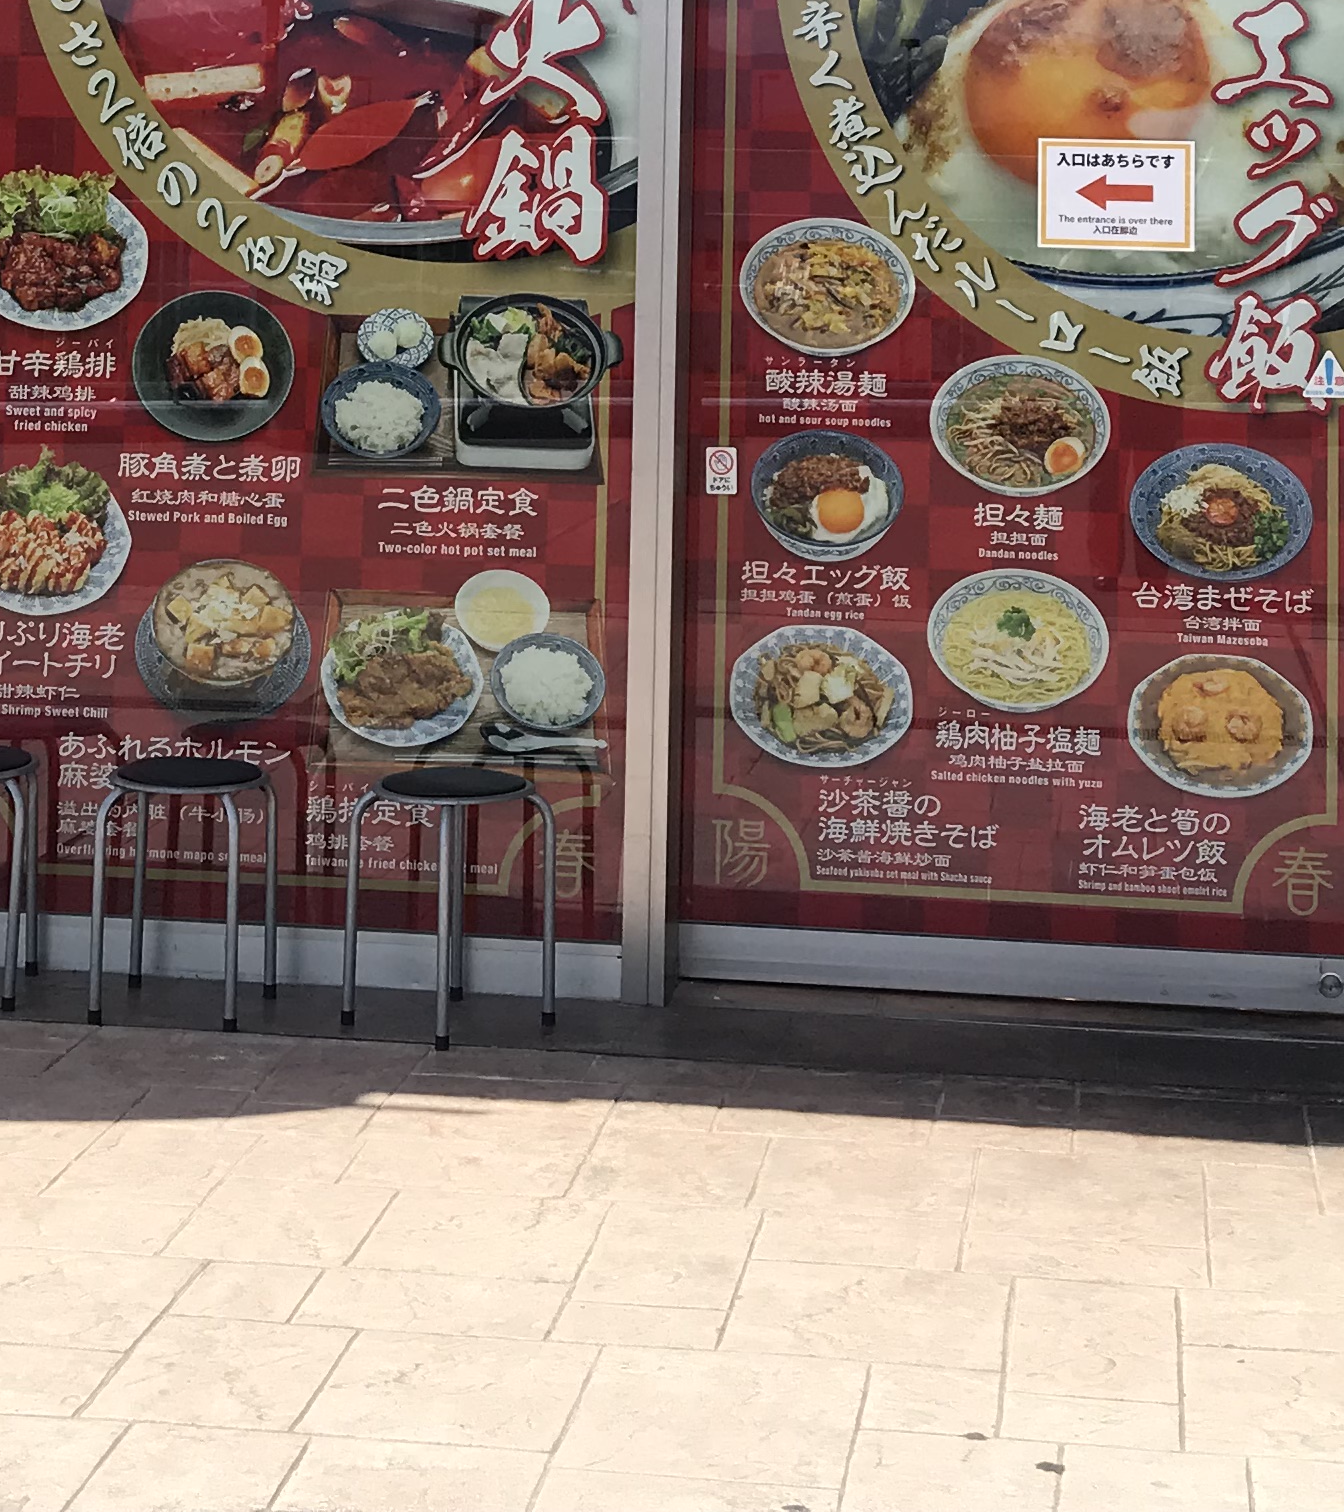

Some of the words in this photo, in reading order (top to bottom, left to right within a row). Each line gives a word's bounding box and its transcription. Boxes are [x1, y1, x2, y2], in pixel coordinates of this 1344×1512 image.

[1056, 152, 1176, 170] 入口はあちらです
[1058, 214, 1075, 225] The
[1077, 215, 1117, 226] entrance
[1119, 217, 1127, 226] is
[1129, 217, 1149, 226] over
[1150, 217, 1174, 227] there
[5, 405, 41, 418] Sweet
[67, 406, 97, 420] spicy
[759, 413, 776, 424] hot
[800, 416, 822, 426] sour
[825, 417, 850, 428] soup
[853, 416, 892, 428] noodles
[14, 418, 41, 432] fried
[44, 419, 88, 432] chicken
[117, 451, 301, 483] 豚角煮と煮卵
[377, 484, 539, 517] 二色鍋定食
[127, 509, 169, 524] Stewed
[172, 510, 201, 524] Pork
[204, 512, 225, 525] and
[228, 512, 264, 526] Boiled
[267, 513, 288, 528] Egg
[378, 541, 438, 556] Two-color
[440, 543, 461, 556] hot
[464, 544, 484, 558] pot
[487, 545, 506, 557] set
[509, 545, 538, 558] meal
[978, 548, 1016, 560] Dandan
[1018, 549, 1059, 562] noodles
[1132, 582, 1315, 614] 台湾まぜそば
[824, 609, 843, 621] egg
[844, 609, 865, 620] rice
[1177, 632, 1214, 645] Taiwan
[1217, 634, 1270, 647] Mazesoba
[1, 703, 41, 719] Shrimp
[44, 705, 80, 718] Sweet
[83, 706, 109, 719] Chili
[930, 770, 962, 783] Salted
[966, 772, 1007, 785] chicken
[1009, 773, 1050, 787] noodles
[1053, 776, 1076, 788] with
[1078, 780, 1103, 790] yuzu
[1078, 803, 1232, 837] 海老と筍の
[817, 816, 1000, 850] 海鮮焼きそば
[183, 851, 214, 863] mapo
[1082, 834, 1228, 866] オムレツ飯
[368, 857, 396, 870] fried
[470, 863, 498, 874] meal
